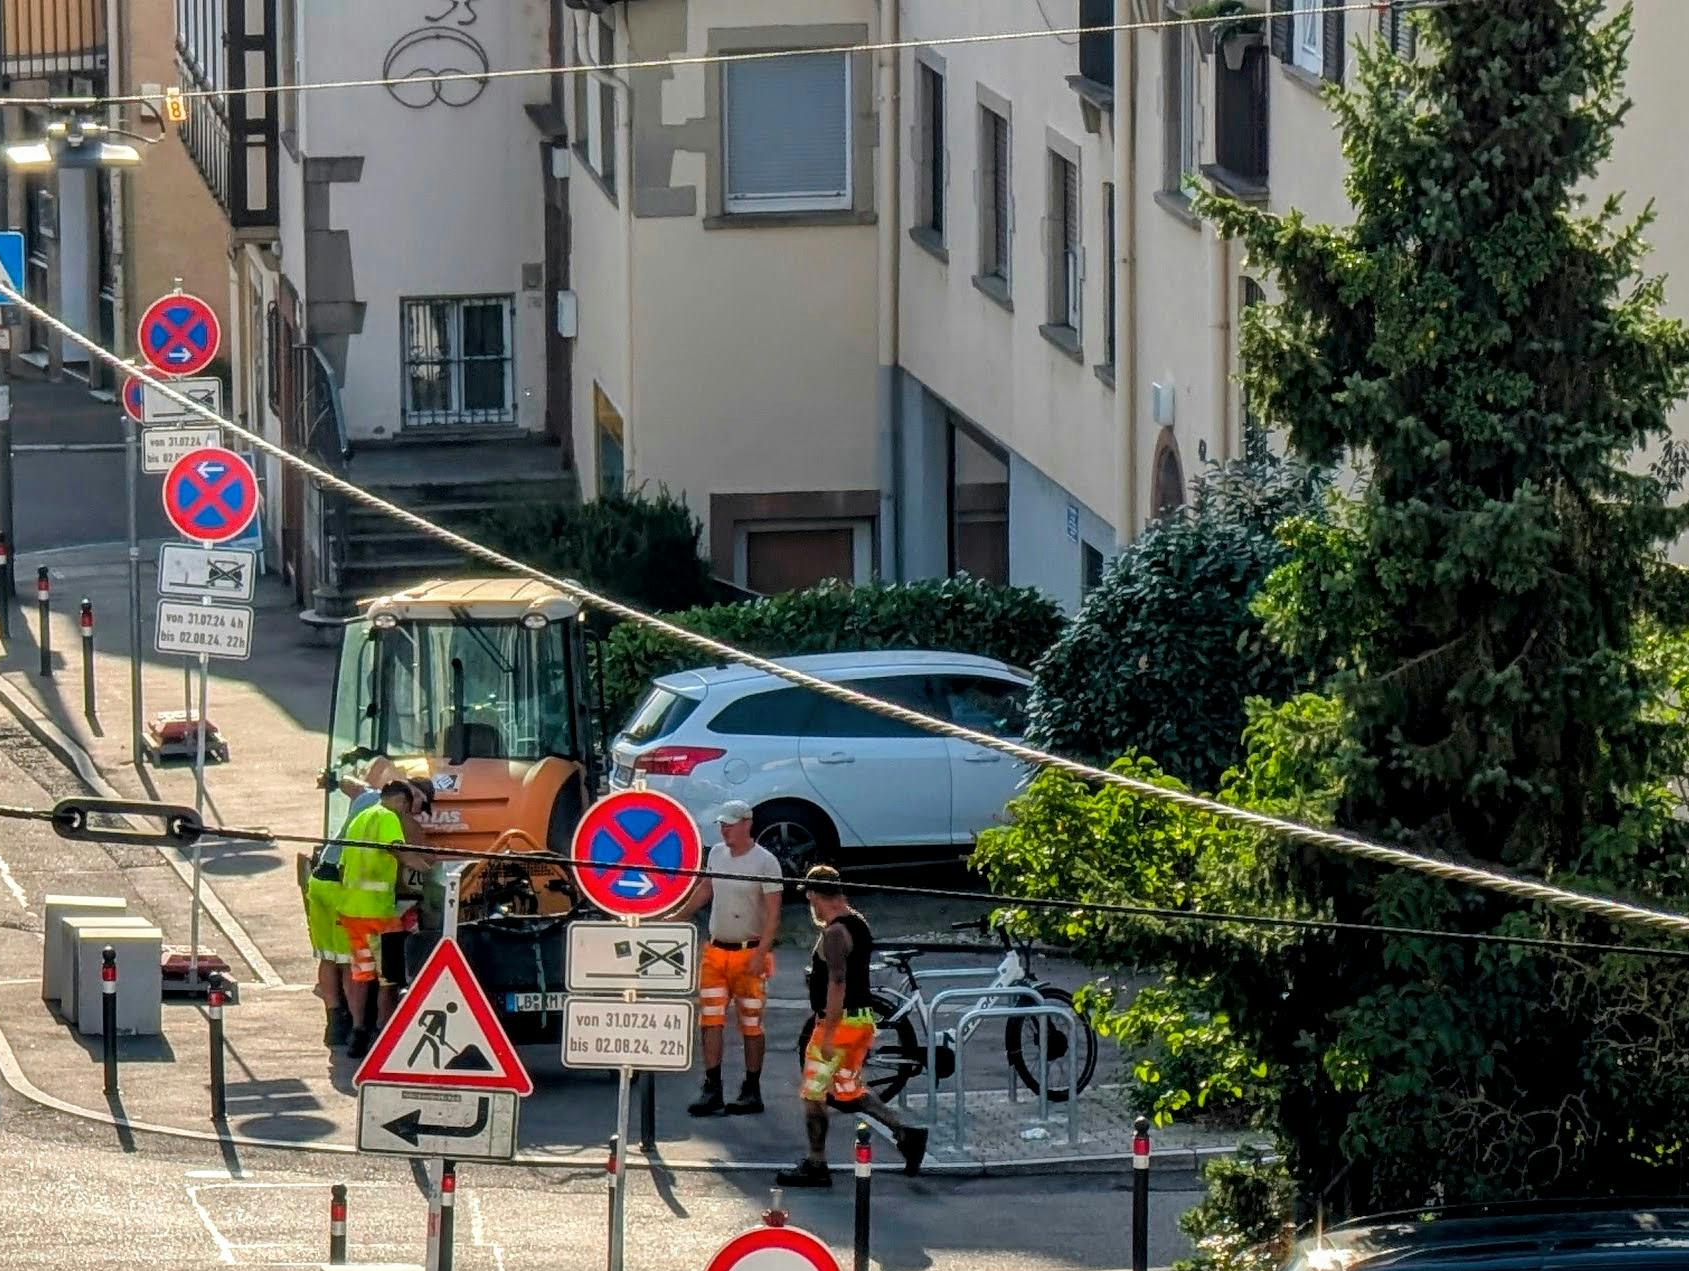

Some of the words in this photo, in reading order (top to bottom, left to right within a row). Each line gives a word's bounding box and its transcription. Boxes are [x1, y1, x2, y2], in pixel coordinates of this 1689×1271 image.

[171, 101, 181, 118] 8
[166, 613, 184, 624] von
[188, 613, 226, 627] 31.07.24
[161, 629, 175, 641] bis
[226, 635, 246, 648] 22h
[576, 1014, 600, 1027] von
[606, 1012, 657, 1030] 31.07.24
[663, 1014, 681, 1030] 4h
[570, 1037, 589, 1053] bis
[660, 1040, 684, 1056] 22h
